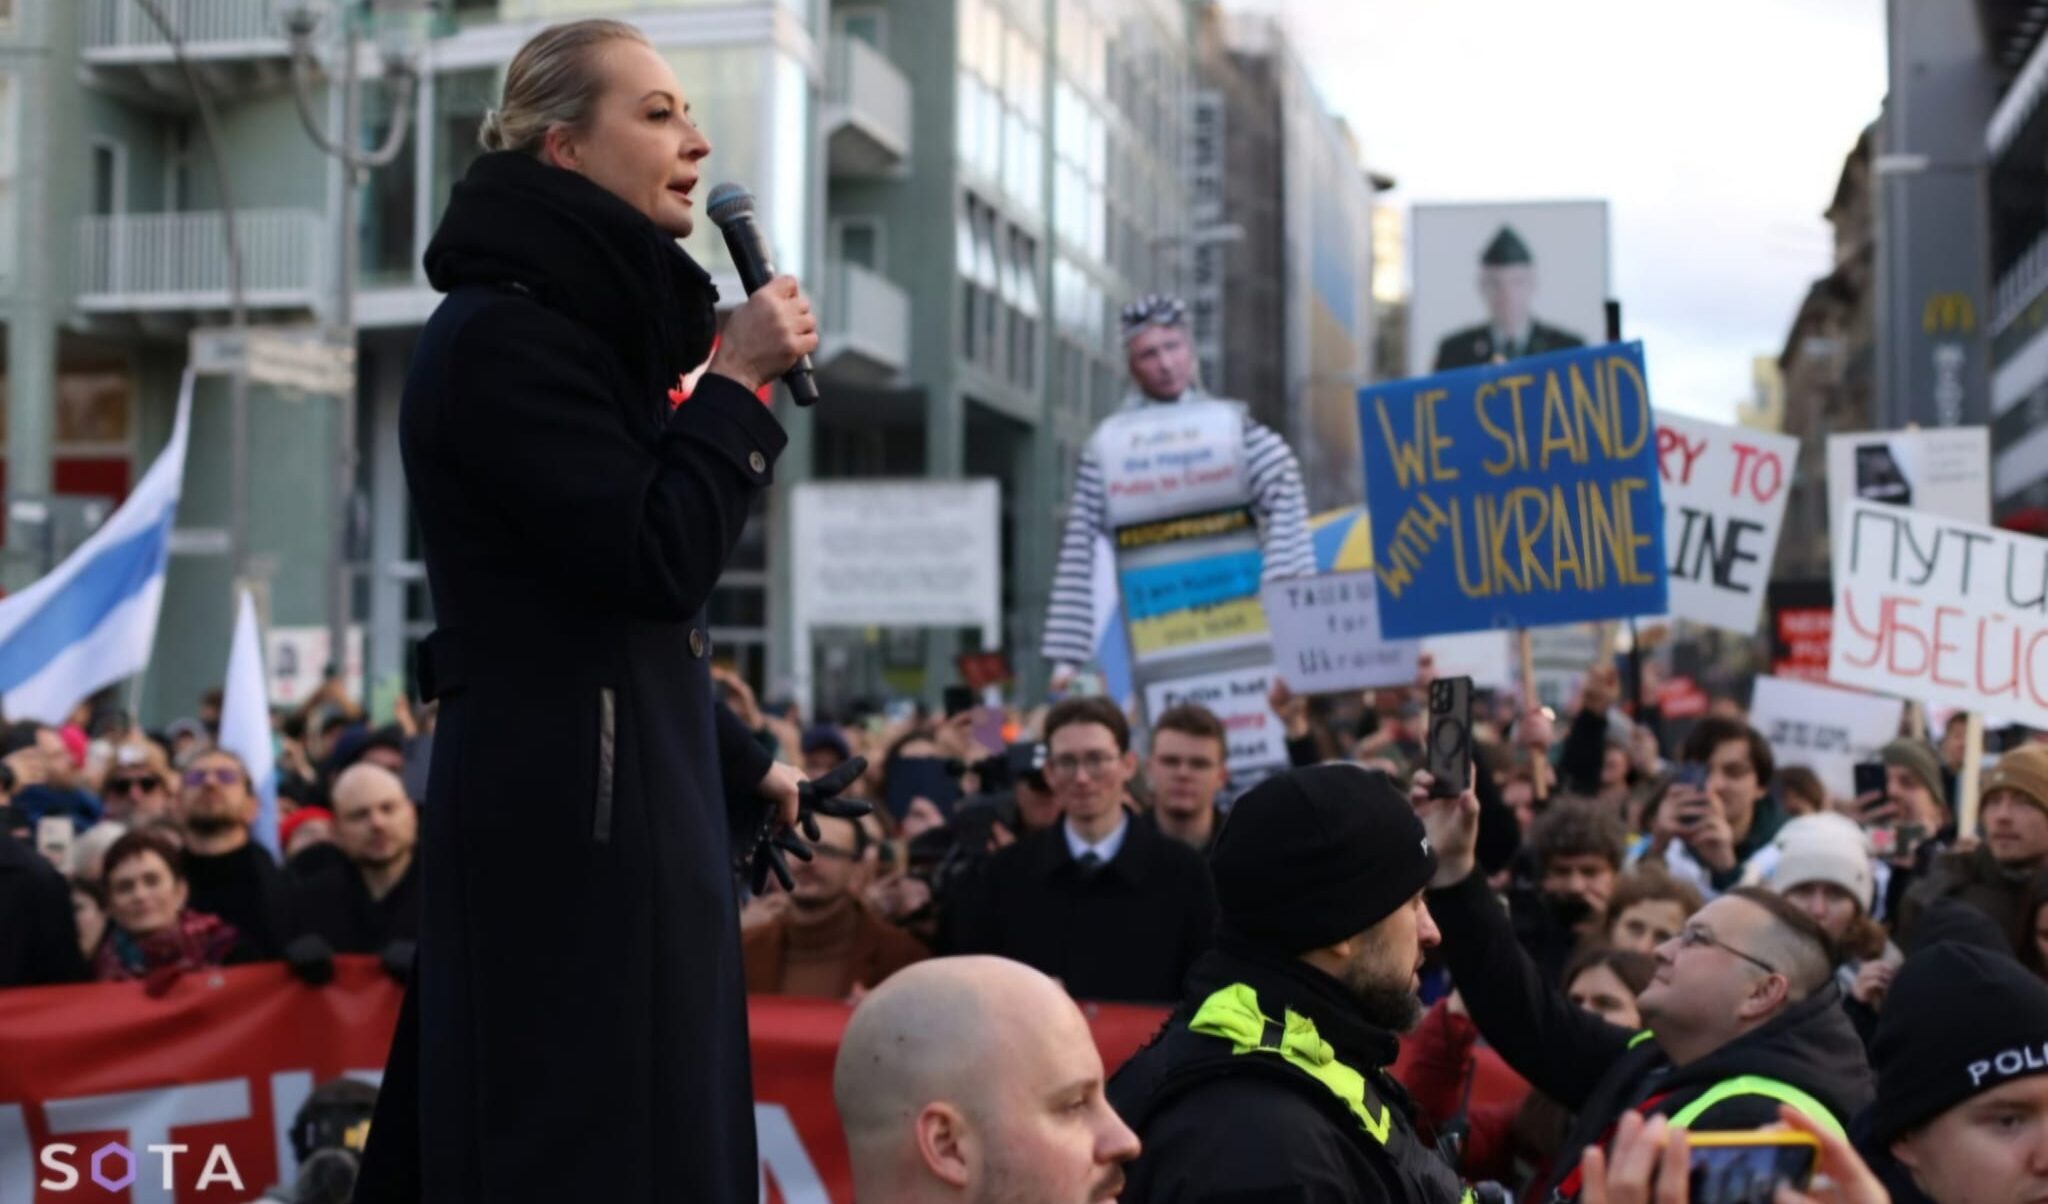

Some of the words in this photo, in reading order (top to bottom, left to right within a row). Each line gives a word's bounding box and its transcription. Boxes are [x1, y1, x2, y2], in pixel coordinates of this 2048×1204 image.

[1375, 389, 1460, 490] WE
[1474, 356, 1650, 476] STAND
[1730, 441, 1784, 504] TO
[1374, 491, 1449, 598] WITH
[1450, 478, 1654, 598] UKRAINE
